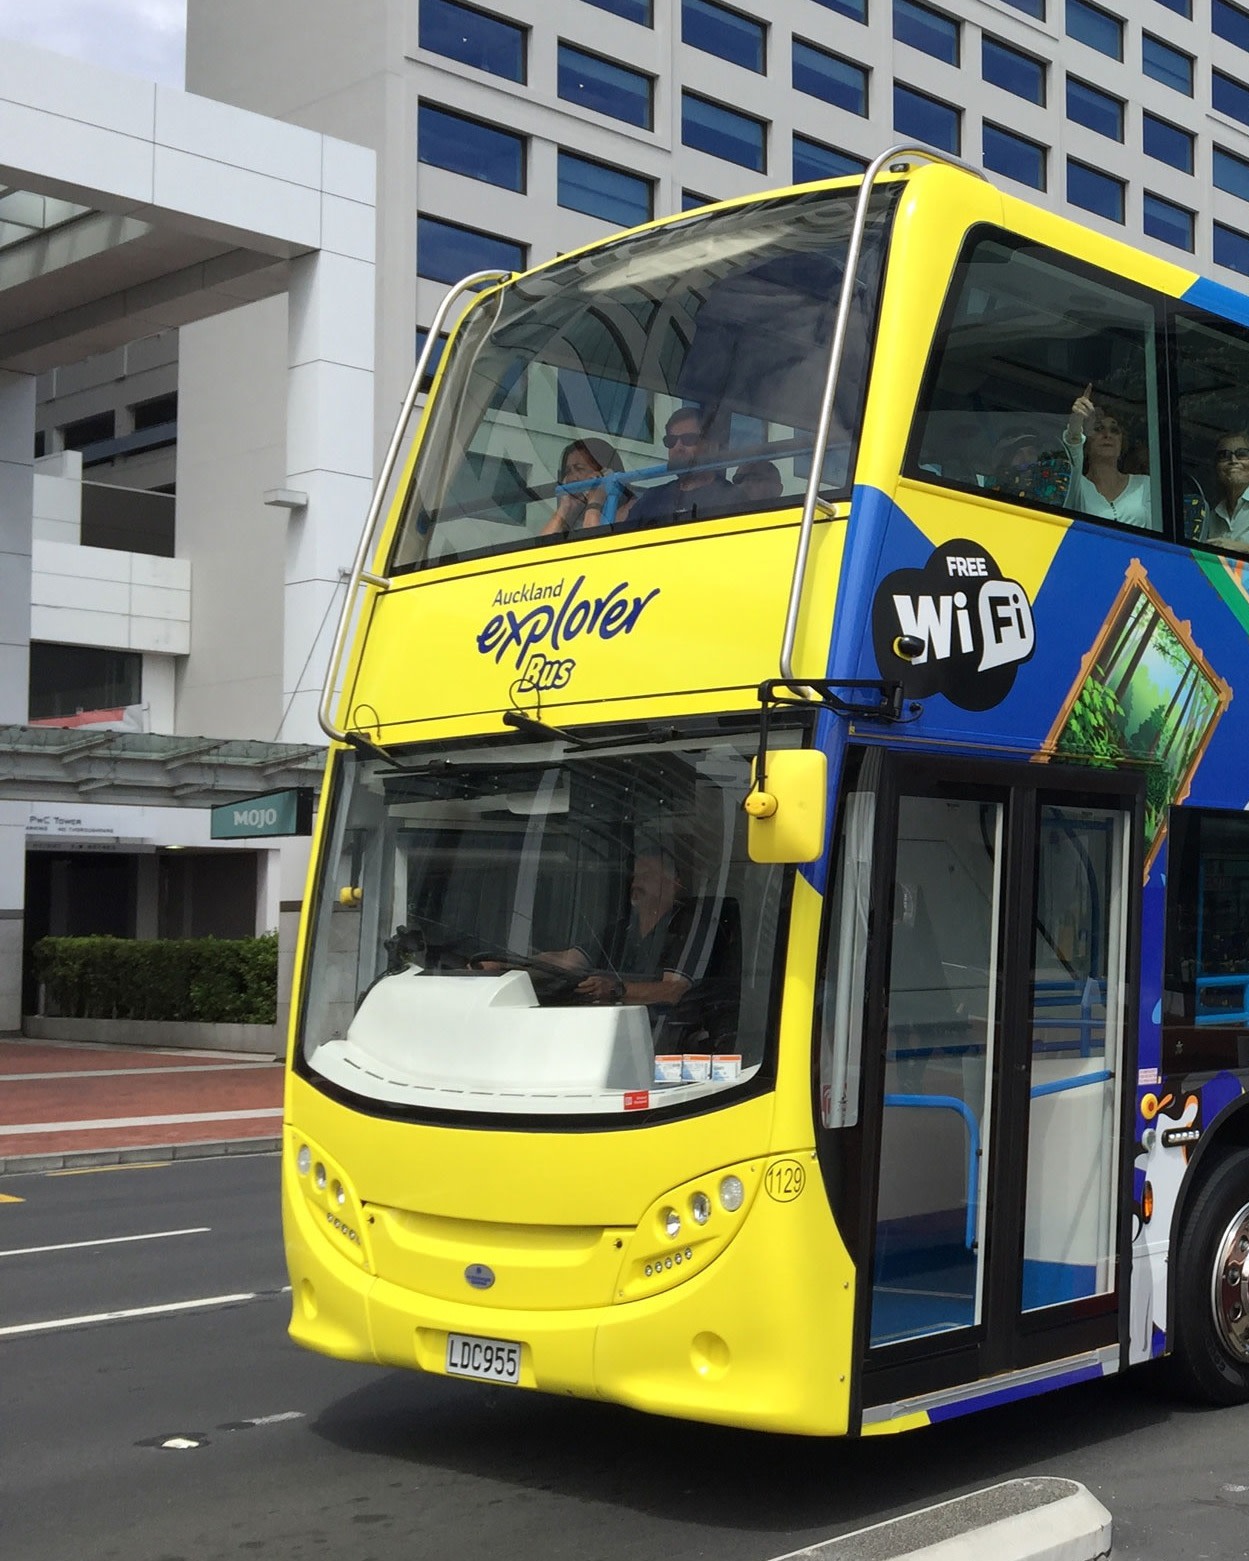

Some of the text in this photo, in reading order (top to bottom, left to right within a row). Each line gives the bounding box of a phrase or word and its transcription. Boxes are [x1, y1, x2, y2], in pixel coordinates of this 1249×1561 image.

[945, 556, 989, 577] FREE
[492, 577, 565, 607] Auckland
[476, 575, 661, 670] explorer
[516, 653, 577, 693] Bus
[29, 815, 51, 825] PwC
[233, 808, 277, 829] MOJO
[768, 1167, 801, 1194] 1129
[448, 1340, 518, 1377] LDC955
